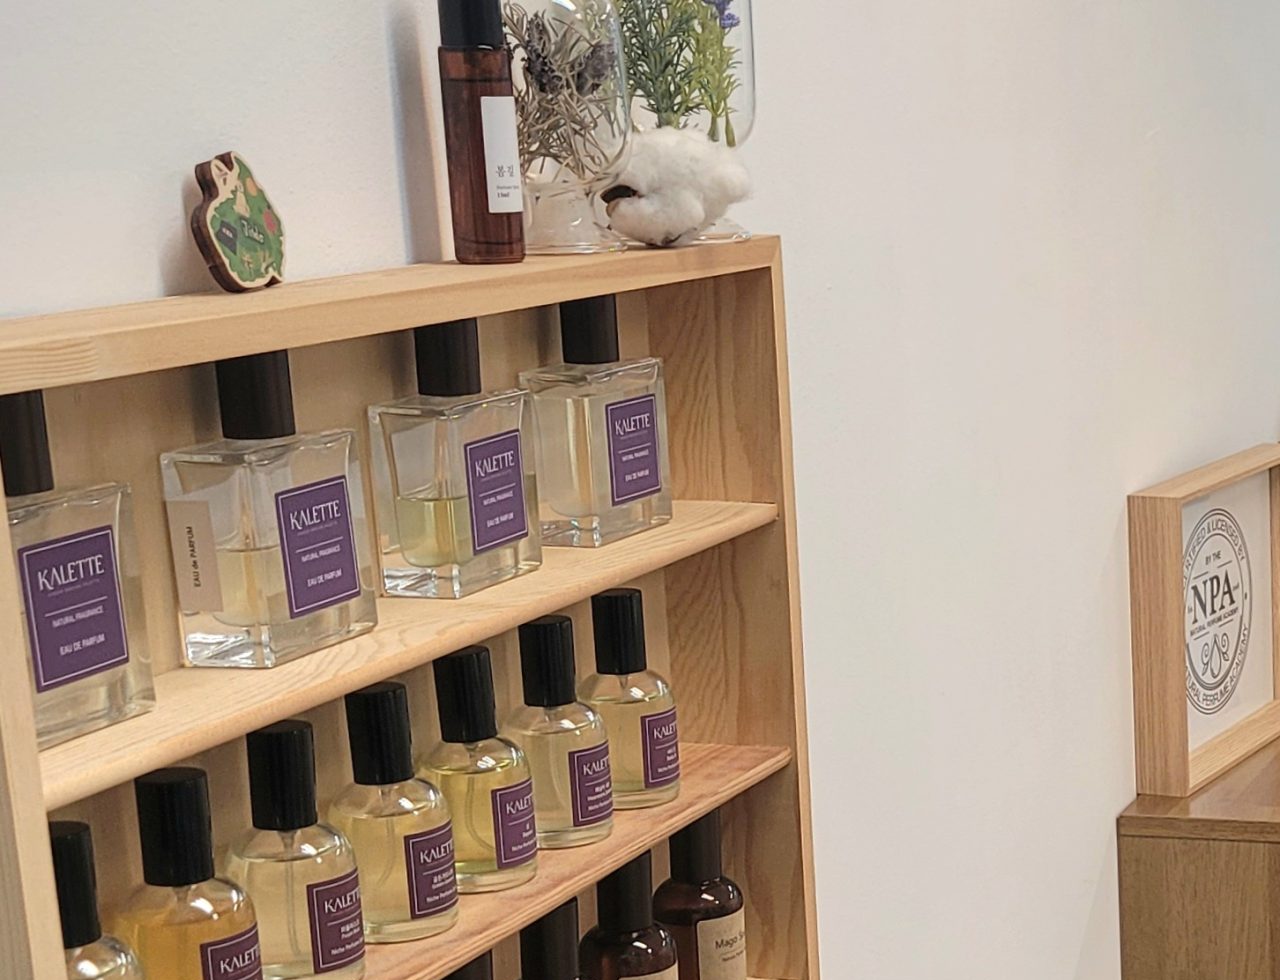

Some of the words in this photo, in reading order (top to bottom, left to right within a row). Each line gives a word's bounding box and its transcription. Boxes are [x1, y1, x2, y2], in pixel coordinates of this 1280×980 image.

[614, 412, 650, 437] KALETTE
[475, 450, 515, 478] KALETTE
[289, 500, 341, 530] KALETTE
[186, 525, 198, 558] PARFUM
[37, 554, 105, 591] KALETTE
[193, 570, 202, 588] EAU
[307, 576, 317, 588] EAU
[324, 567, 343, 583] PARFUM
[1191, 568, 1236, 625] NPA
[52, 614, 76, 629] NATURAL
[59, 643, 73, 656] EAU
[73, 640, 82, 652] DE
[82, 633, 105, 650] PARFUM
